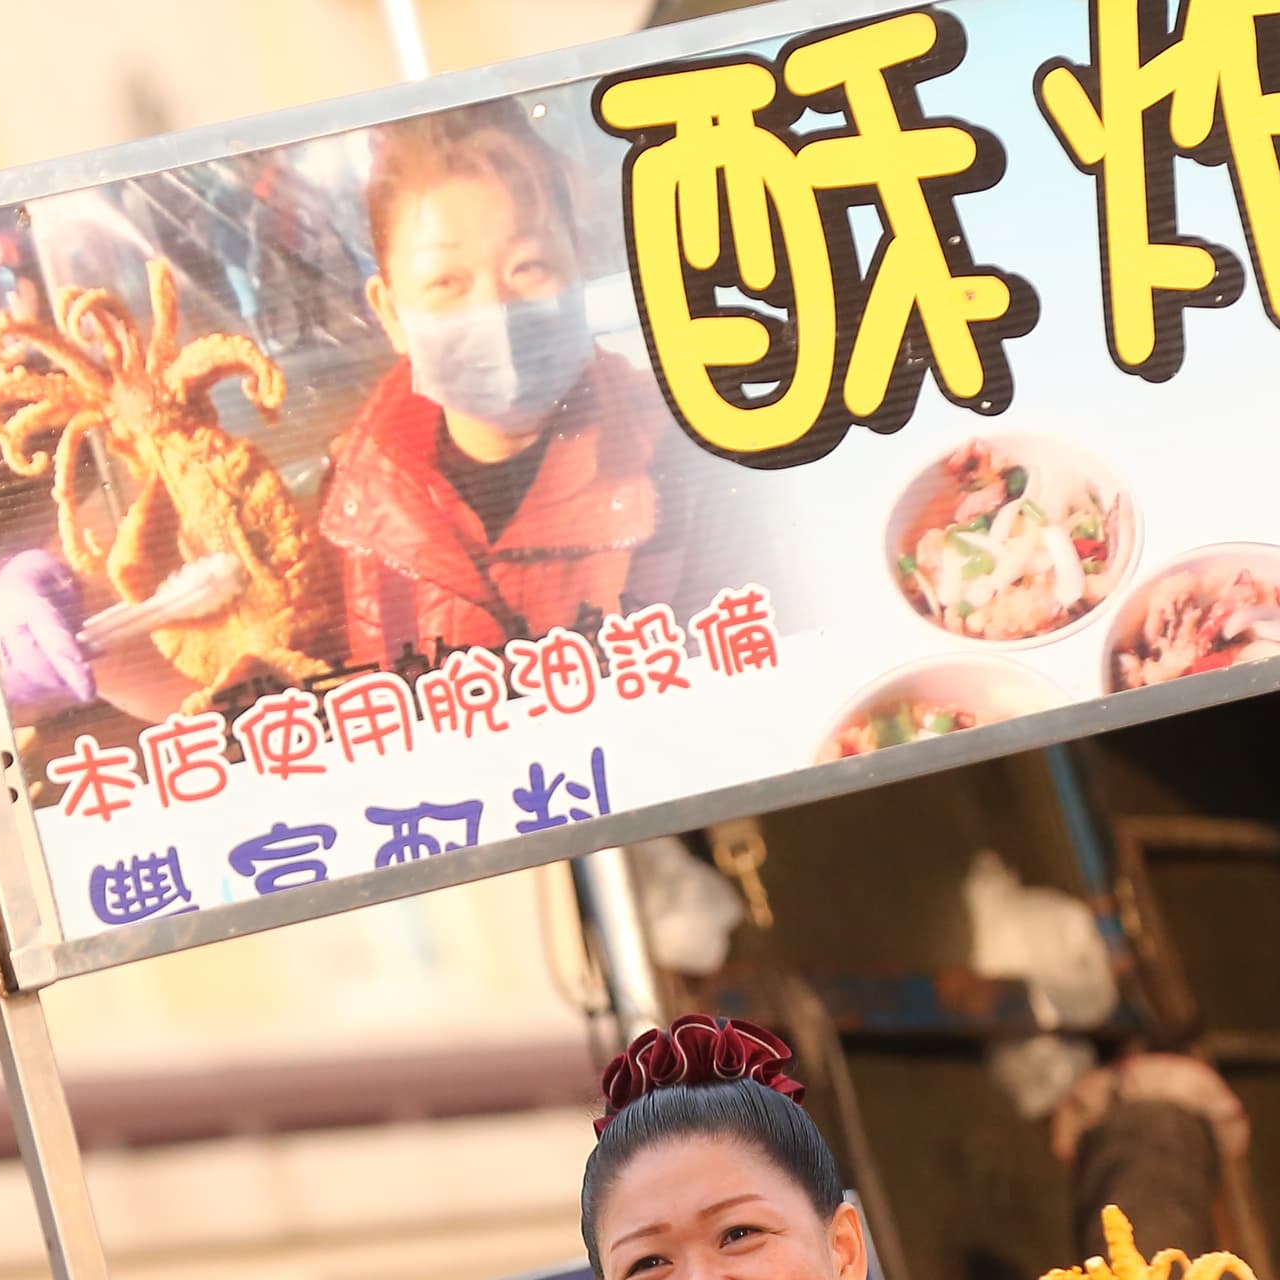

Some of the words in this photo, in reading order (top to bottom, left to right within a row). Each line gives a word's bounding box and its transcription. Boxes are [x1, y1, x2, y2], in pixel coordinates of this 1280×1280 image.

[54, 590, 781, 821] 本店使用脫油設備
